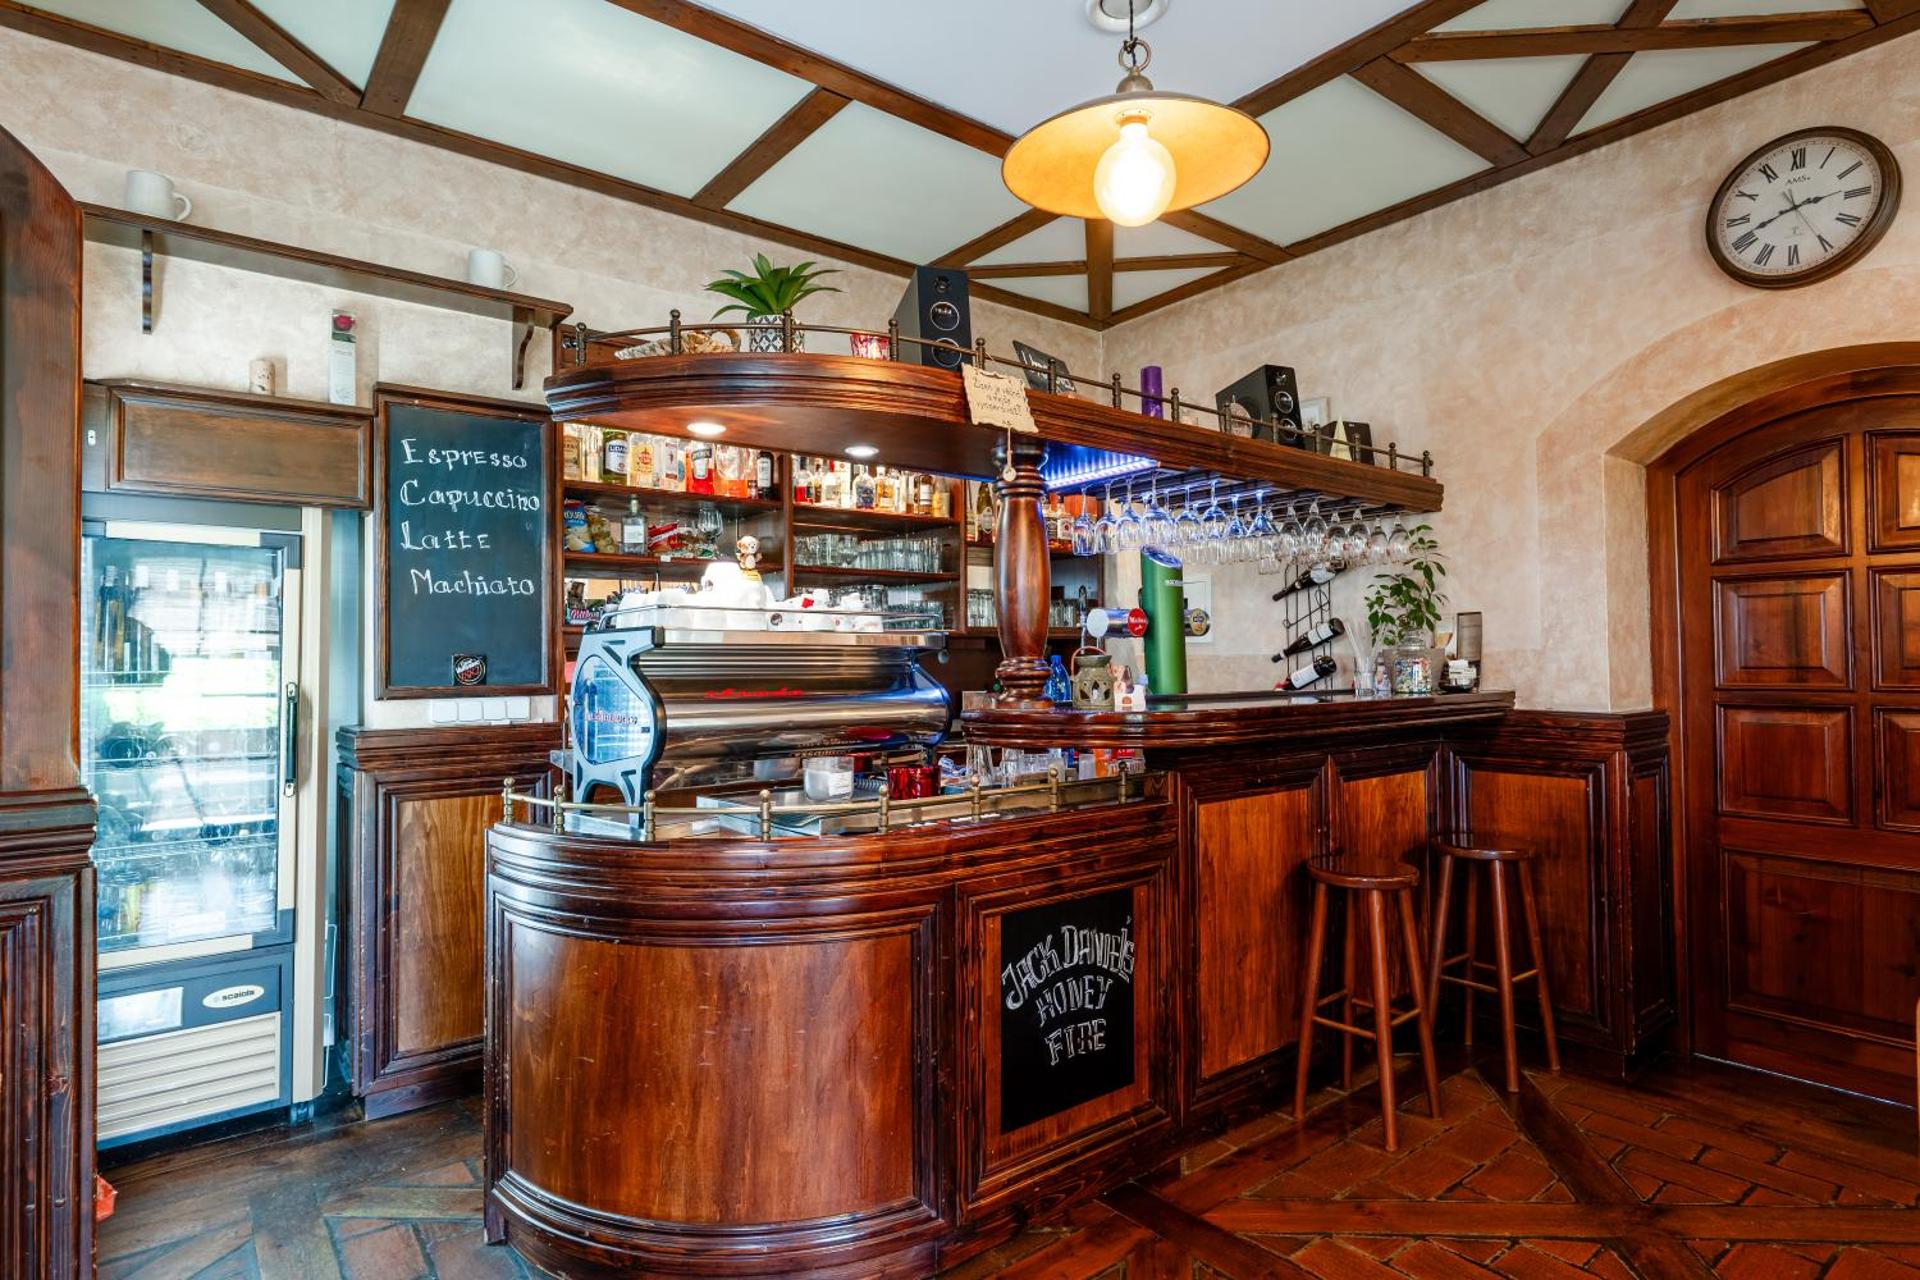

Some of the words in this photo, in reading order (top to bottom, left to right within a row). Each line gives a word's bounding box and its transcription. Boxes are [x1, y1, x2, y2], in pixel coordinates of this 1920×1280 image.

[1758, 163, 1779, 184] XI
[1790, 147, 1806, 172] XII
[1735, 190, 1759, 202] X
[399, 480, 541, 513] Capuccino
[410, 568, 535, 596] Machiato
[1001, 933, 1062, 1010] JACK
[1035, 975, 1113, 1028] HONEY
